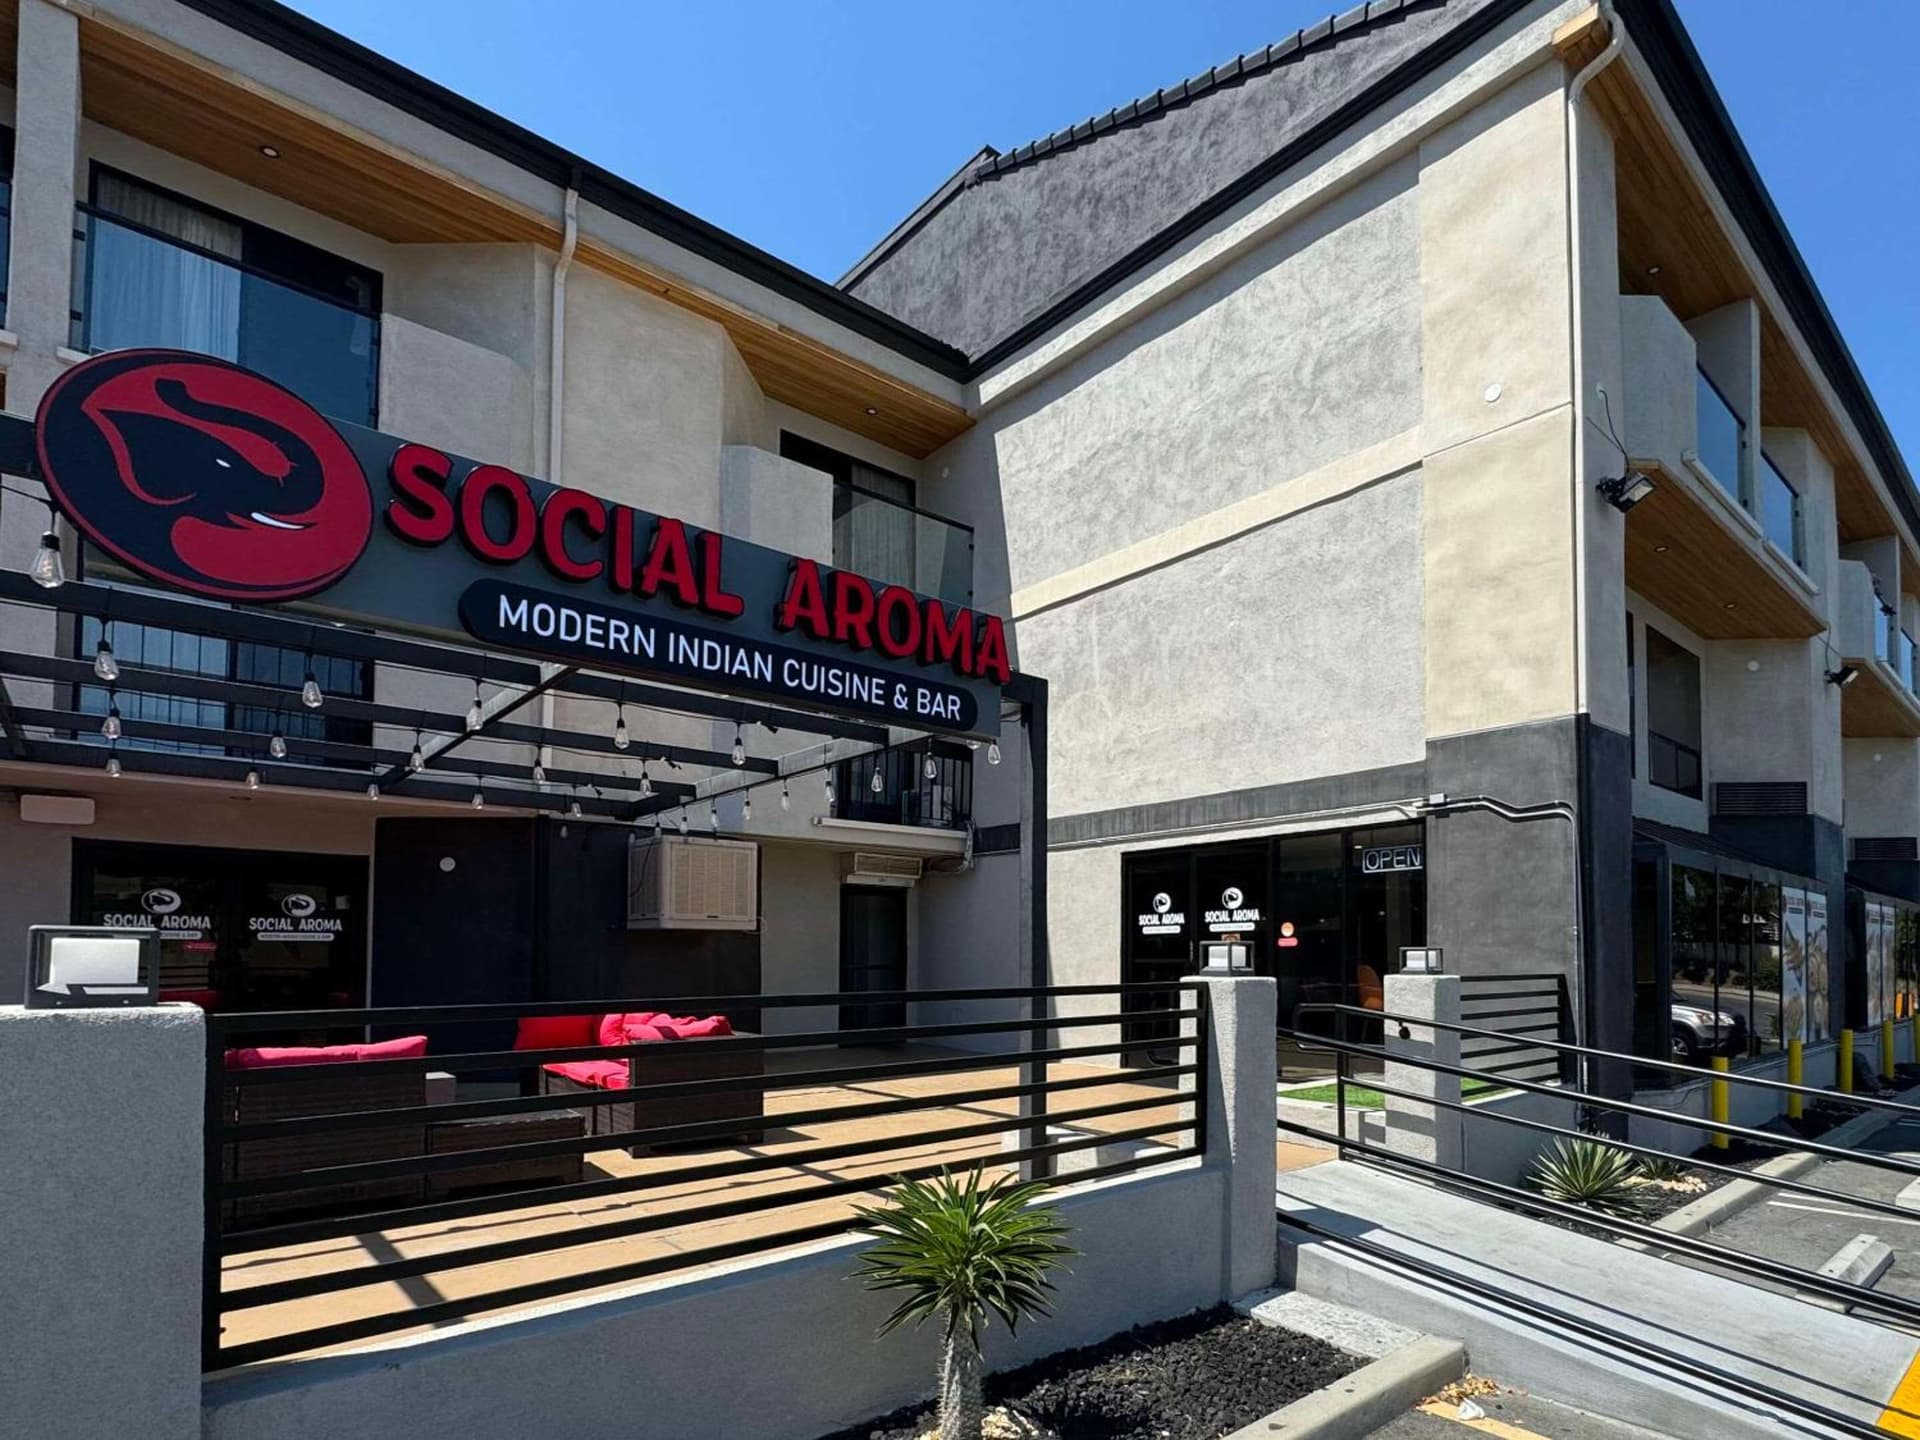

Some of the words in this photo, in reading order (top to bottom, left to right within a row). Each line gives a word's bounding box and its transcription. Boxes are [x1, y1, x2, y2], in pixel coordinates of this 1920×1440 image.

[384, 443, 744, 618] SOCIAL
[776, 558, 1012, 684] AROMA
[500, 594, 655, 658] MODERN
[669, 632, 772, 682] INDIAN
[783, 658, 885, 706] CUISINE
[893, 684, 908, 709] &
[917, 688, 960, 720] BAR
[1366, 848, 1420, 869] OPEN
[104, 914, 155, 927] SOCIAL
[160, 915, 211, 929] AROMA
[1138, 914, 1160, 926] SOCIAL
[1162, 913, 1185, 925] AROMA
[1204, 911, 1230, 923] SOCIAL
[1232, 909, 1260, 921] AROMA
[249, 917, 294, 931] SOCIAL
[299, 918, 343, 931] AROMA
